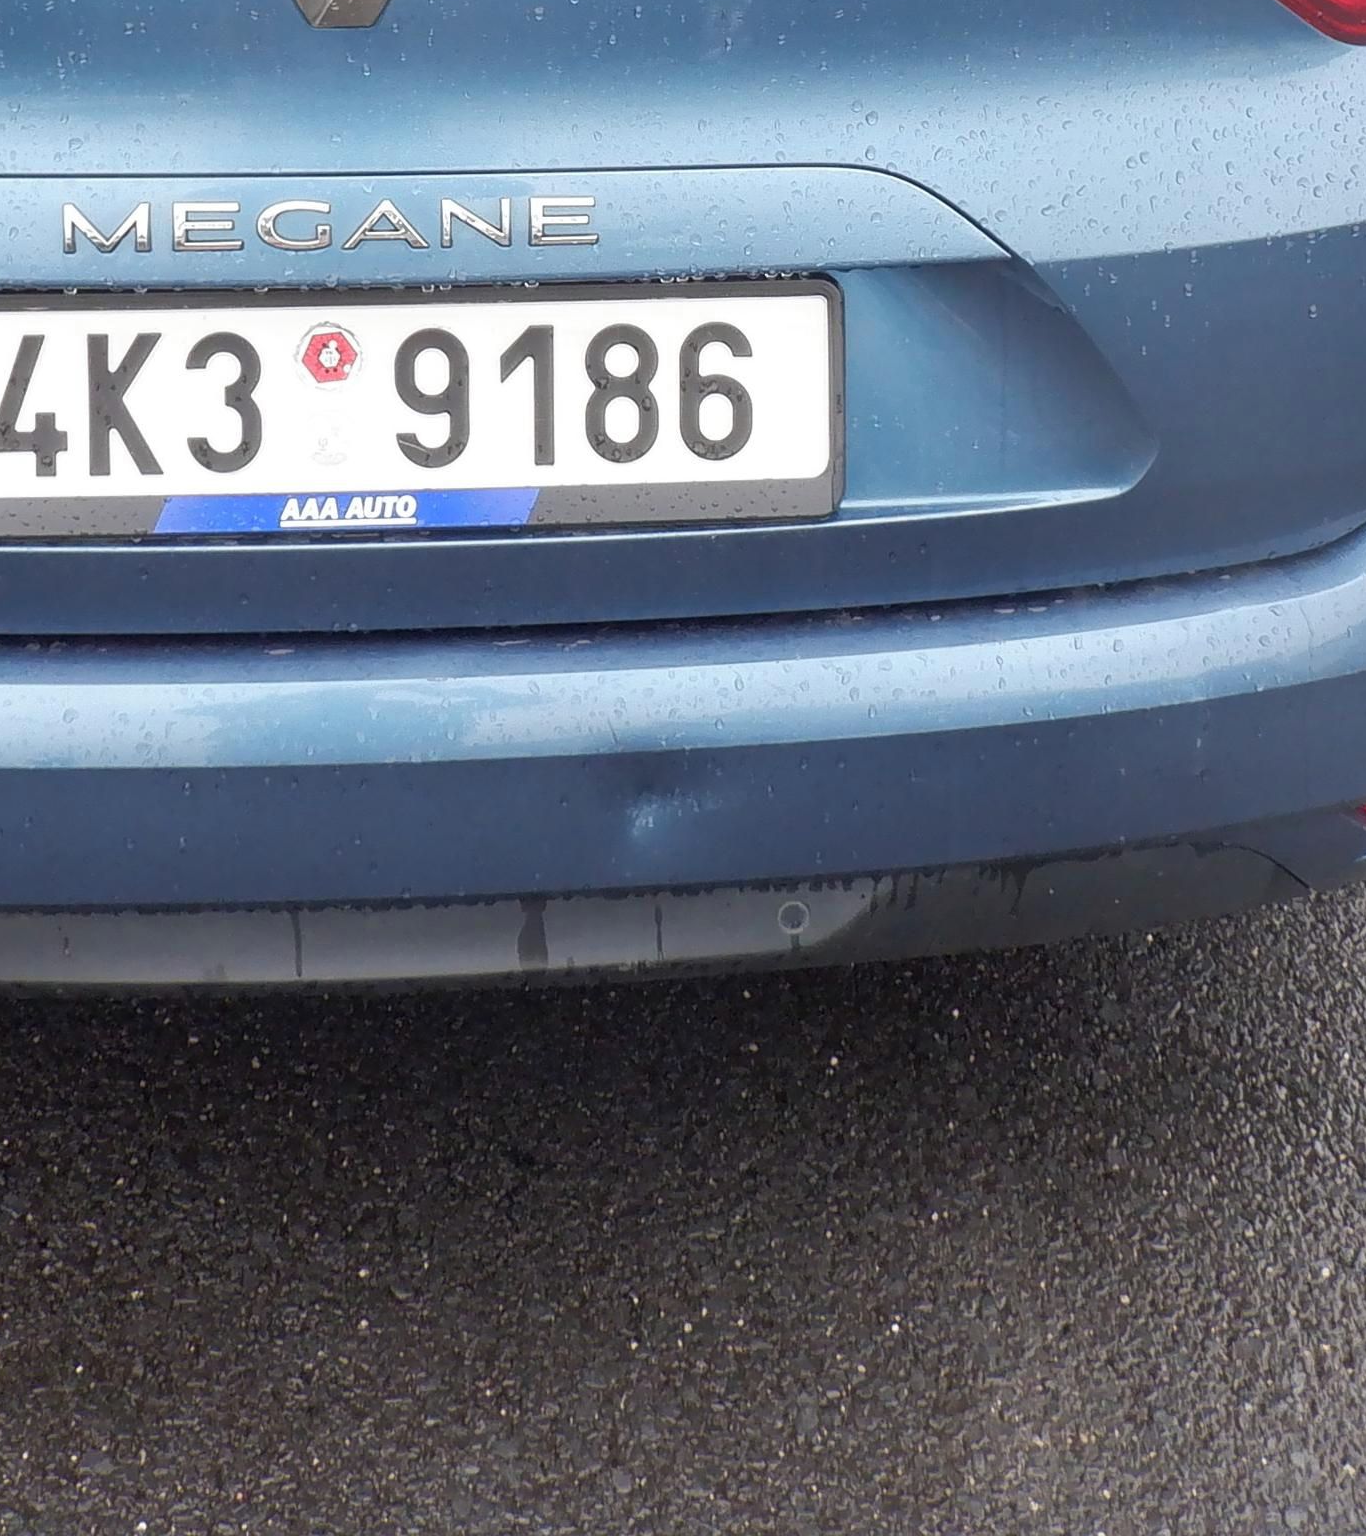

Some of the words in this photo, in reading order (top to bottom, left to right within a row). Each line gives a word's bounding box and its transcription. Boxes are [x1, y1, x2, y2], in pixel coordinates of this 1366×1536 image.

[61, 196, 600, 253] MEGANE
[394, 321, 754, 469] 9186
[280, 496, 341, 522] AAA
[344, 494, 418, 520] AUTO
